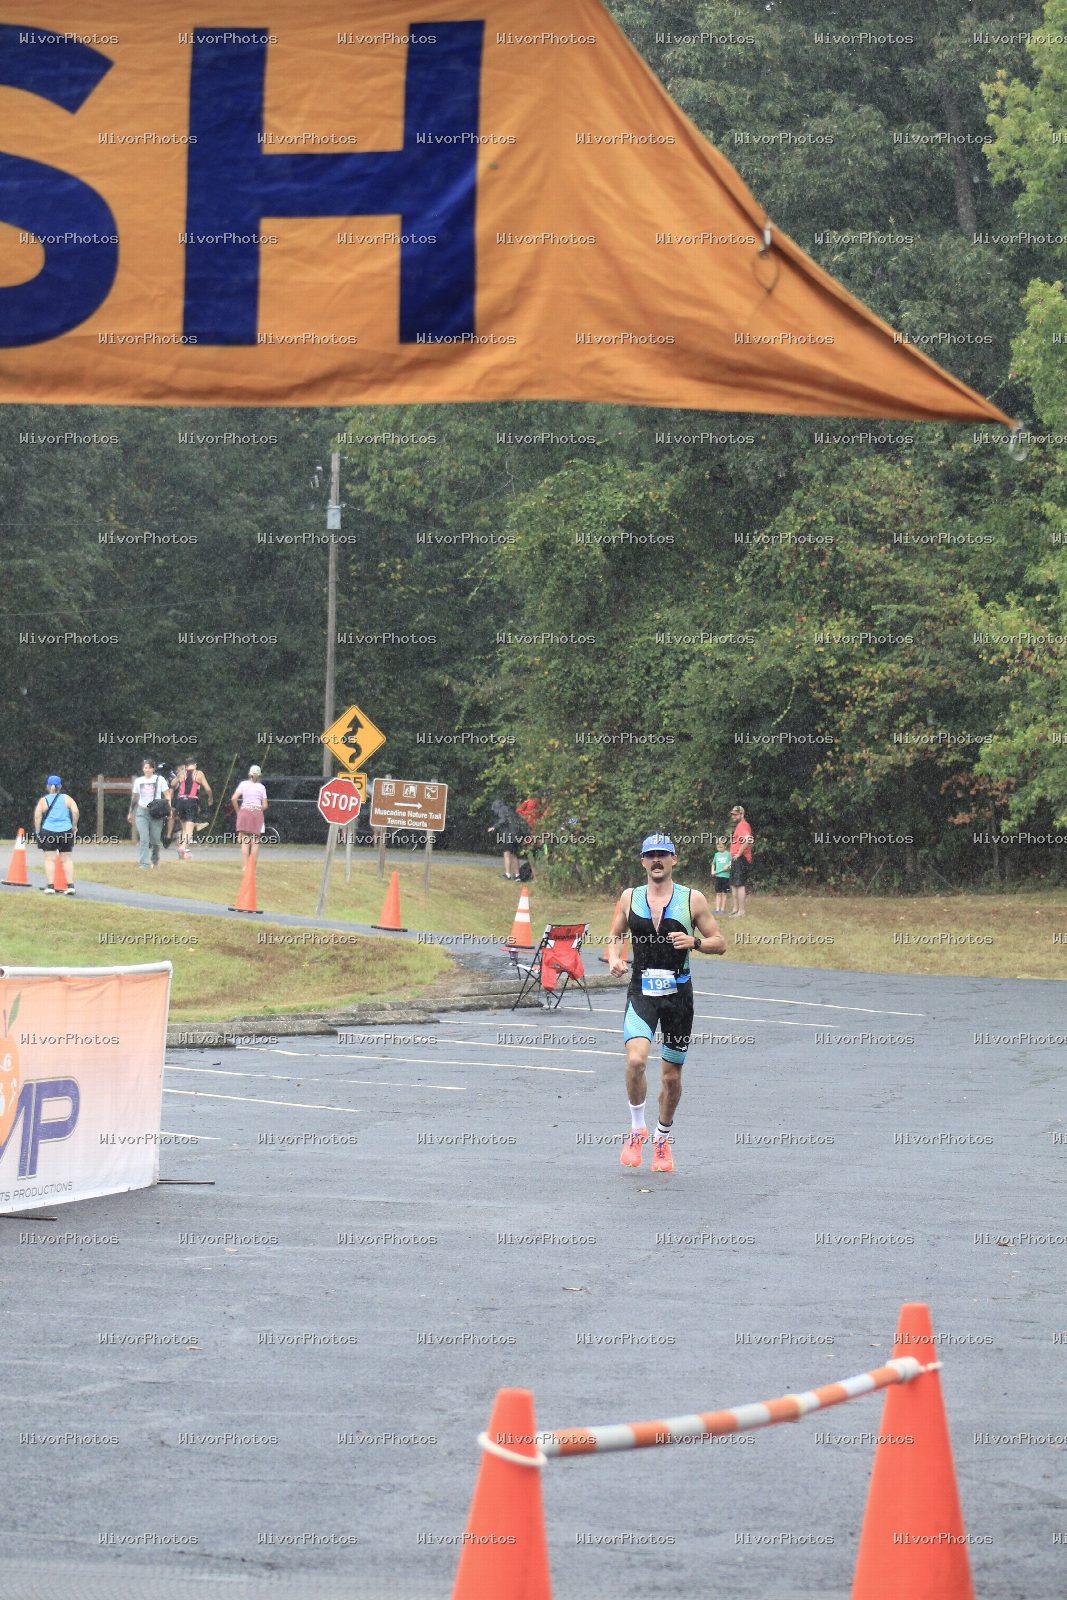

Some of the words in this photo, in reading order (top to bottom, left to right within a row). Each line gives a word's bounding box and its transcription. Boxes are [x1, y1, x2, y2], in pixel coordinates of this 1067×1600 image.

[321, 790, 359, 812] STOP
[374, 807, 407, 817] Muscadine
[407, 810, 428, 818] Nature
[429, 812, 442, 820] Trail
[387, 817, 407, 825] Tennis
[407, 819, 428, 828] Courts
[647, 978, 672, 990] 198
[13, 1181, 73, 1199] PRODUCTIONS
